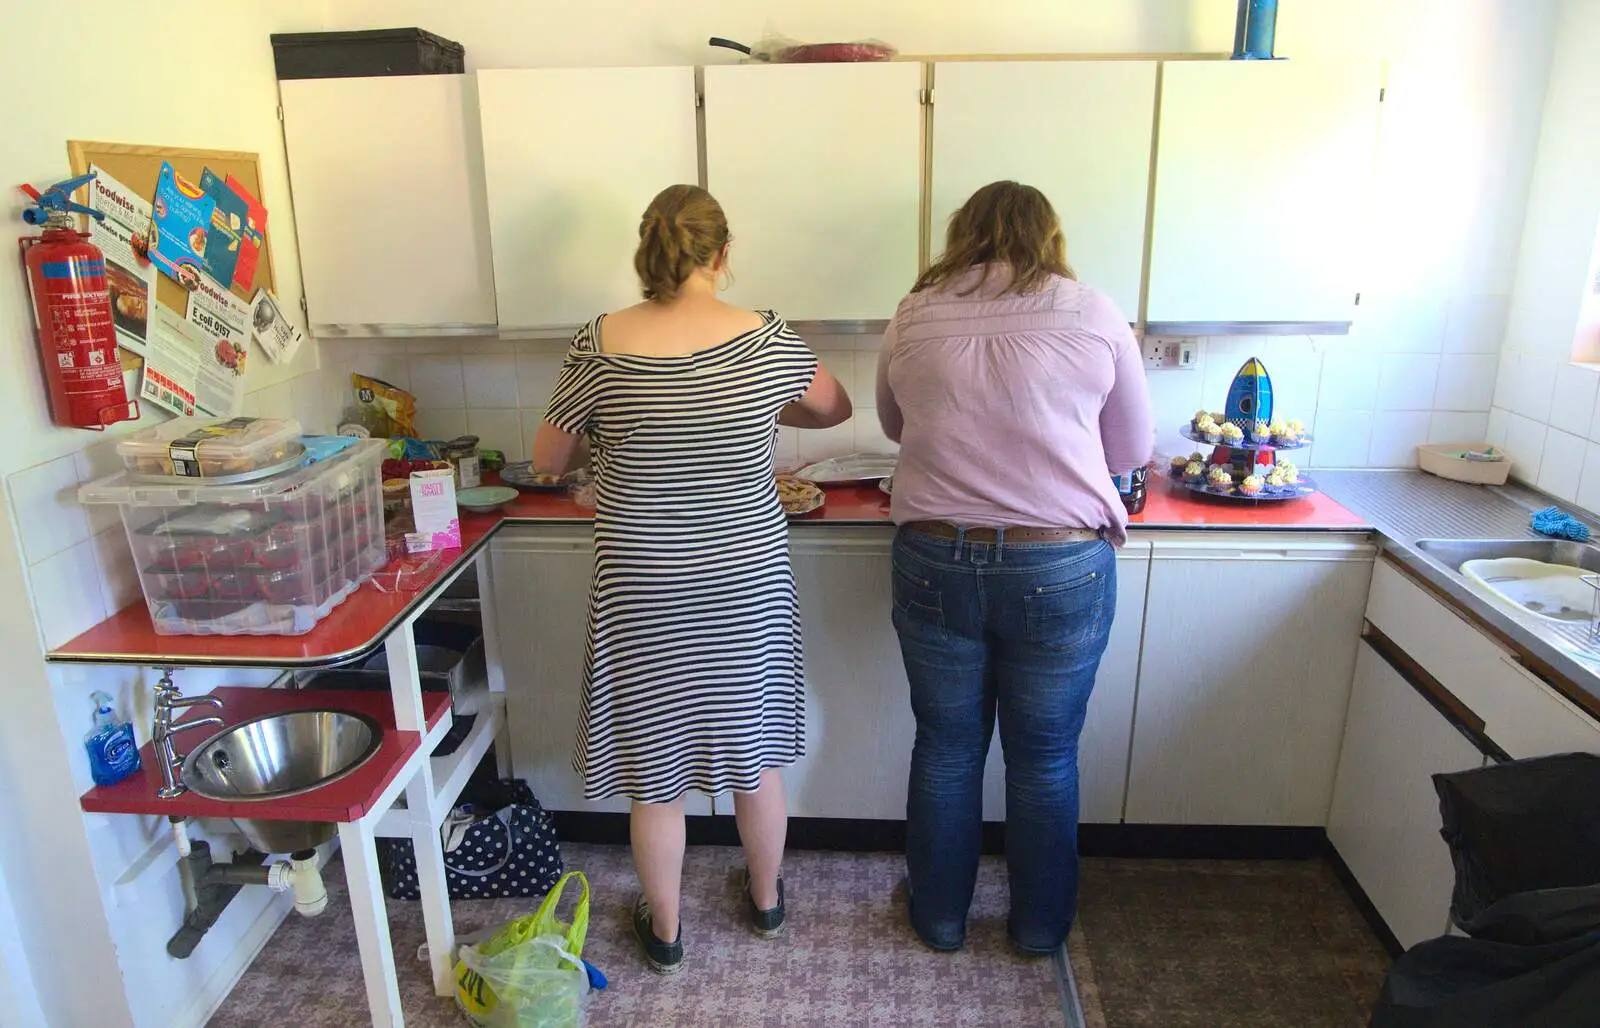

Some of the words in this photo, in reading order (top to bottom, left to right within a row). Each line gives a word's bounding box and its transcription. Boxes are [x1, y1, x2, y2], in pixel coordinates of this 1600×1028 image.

[95, 179, 135, 213] Foodwise
[192, 307, 198, 318] E
[199, 313, 214, 328] coli
